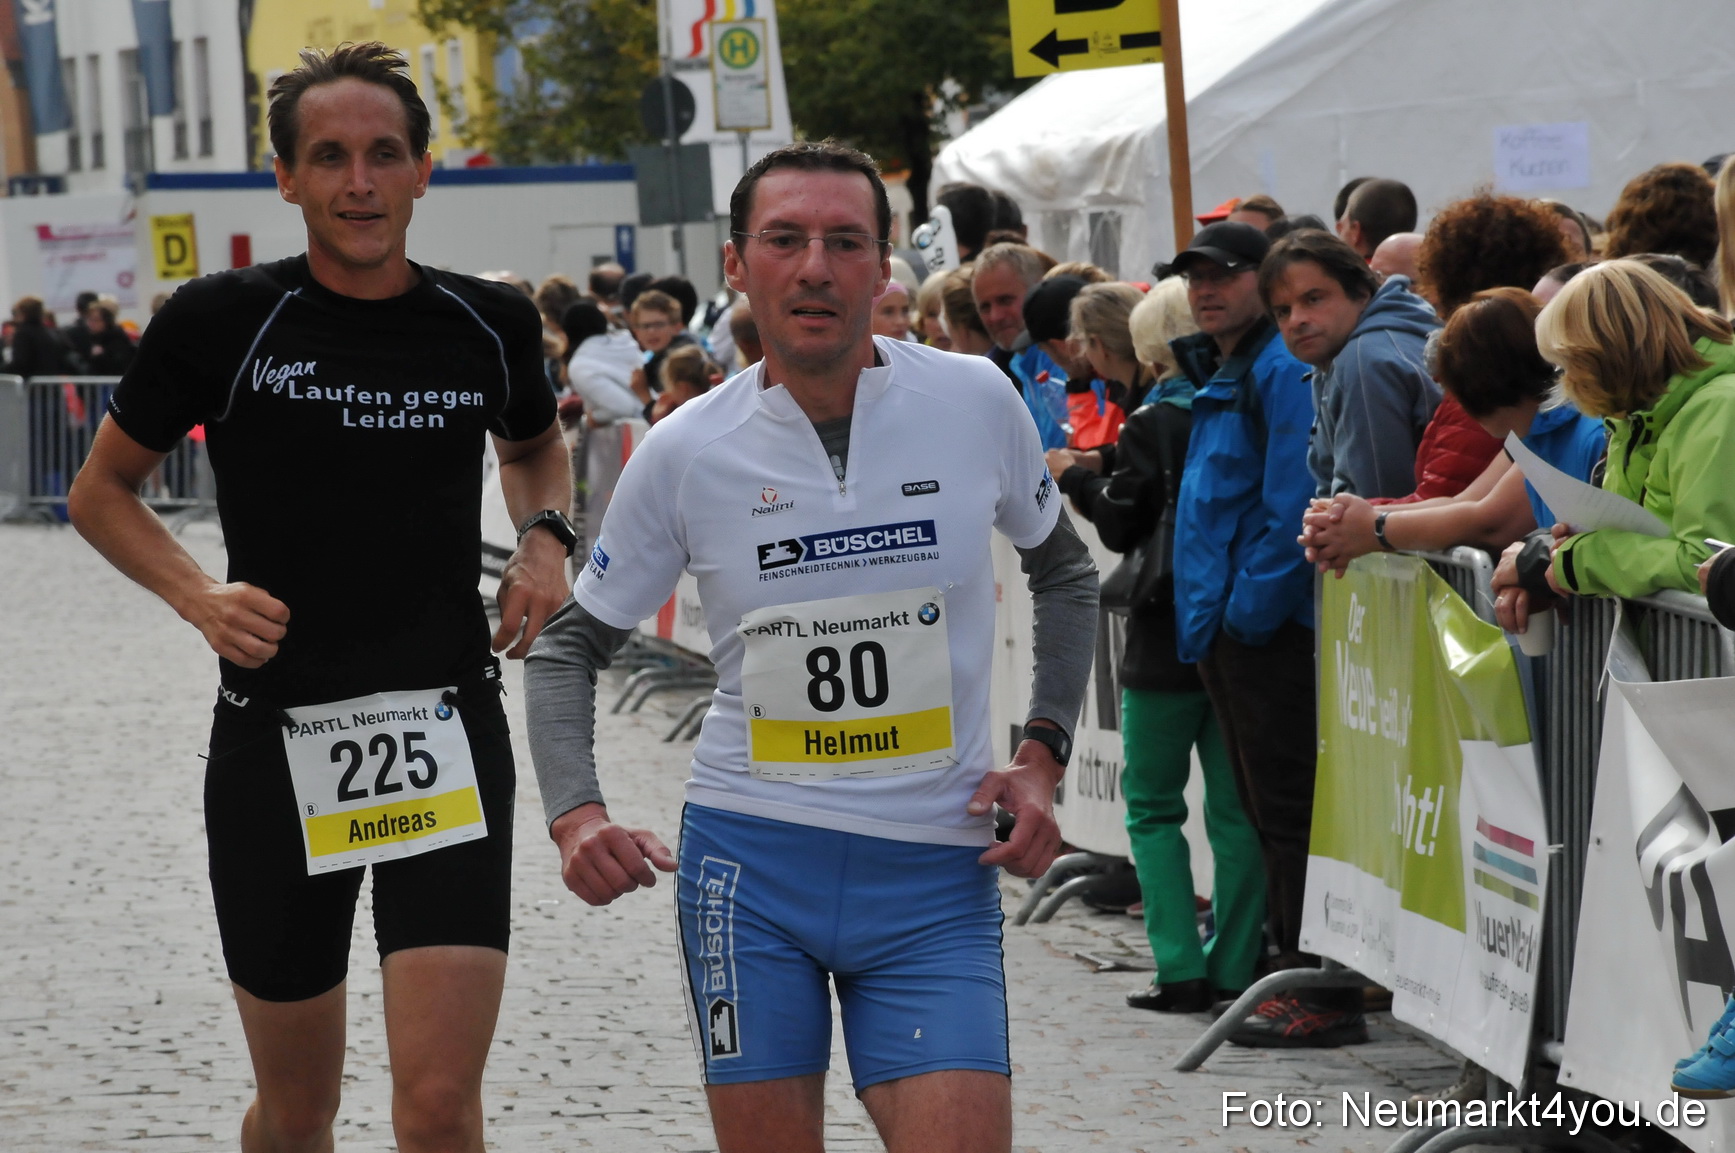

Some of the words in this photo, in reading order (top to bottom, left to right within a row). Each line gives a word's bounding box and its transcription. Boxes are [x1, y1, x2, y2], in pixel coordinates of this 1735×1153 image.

[729, 38, 749, 59] H
[163, 233, 188, 266] D
[252, 356, 317, 394] Vegan
[288, 380, 392, 405] Laufen
[403, 389, 484, 410] gegen
[343, 408, 445, 429] Leiden
[904, 481, 936, 492] BASE
[751, 500, 795, 517] Nalini
[813, 526, 931, 556] BÜSCHEL
[759, 559, 860, 582] FEINSCHNEIDTECHNIK
[869, 551, 940, 566] WERKZEUGBAU
[743, 621, 808, 638] PARTL
[812, 611, 910, 637] Neumarkt
[805, 640, 889, 713] 80
[288, 717, 349, 739] PARTL
[352, 706, 429, 728] Neumarkt
[804, 725, 900, 756] Helmut
[329, 731, 439, 803] 225
[348, 810, 437, 844] Andreas
[705, 872, 727, 991] BÜSCHEL
